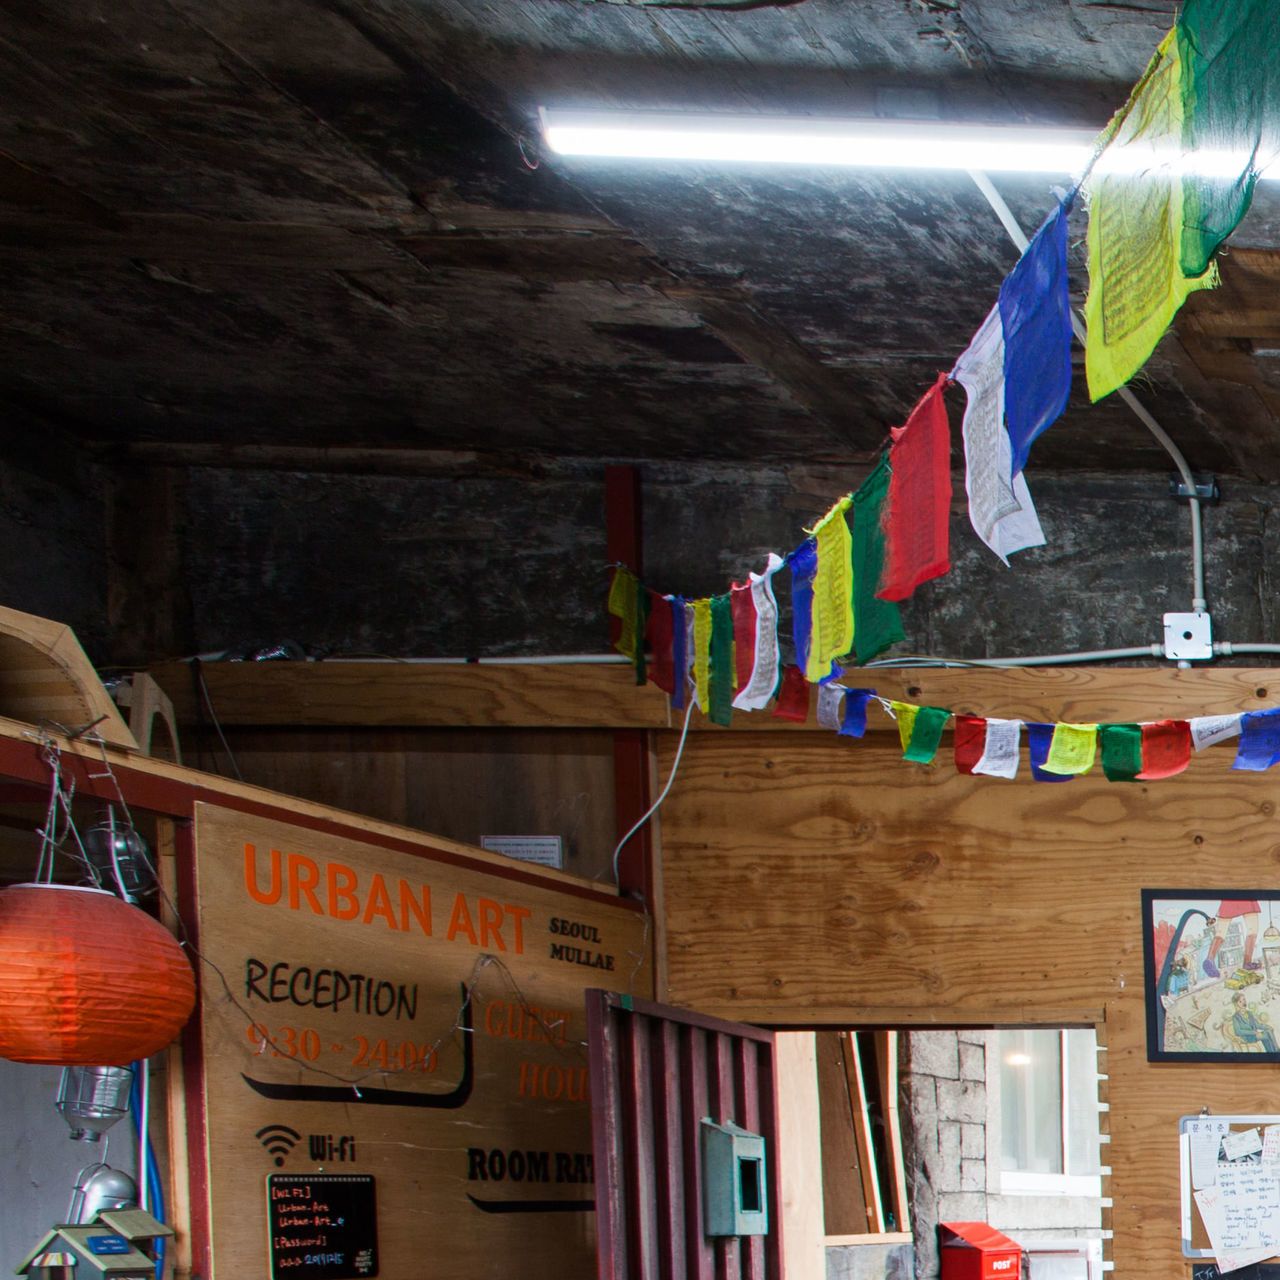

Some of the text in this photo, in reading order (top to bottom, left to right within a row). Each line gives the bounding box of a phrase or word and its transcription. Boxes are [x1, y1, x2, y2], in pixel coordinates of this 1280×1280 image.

[244, 843, 531, 955] URBAN ART
[550, 916, 601, 944] SEOUL
[550, 943, 615, 972] MULLAE
[246, 959, 417, 1021] RECEPTION
[484, 1001, 572, 1046] GUEST
[247, 1024, 321, 1062] 9:30
[351, 1034, 438, 1074] 24:00
[519, 1061, 590, 1102] HOU
[468, 1148, 550, 1182] ROOM
[993, 1260, 1012, 1270] POST
